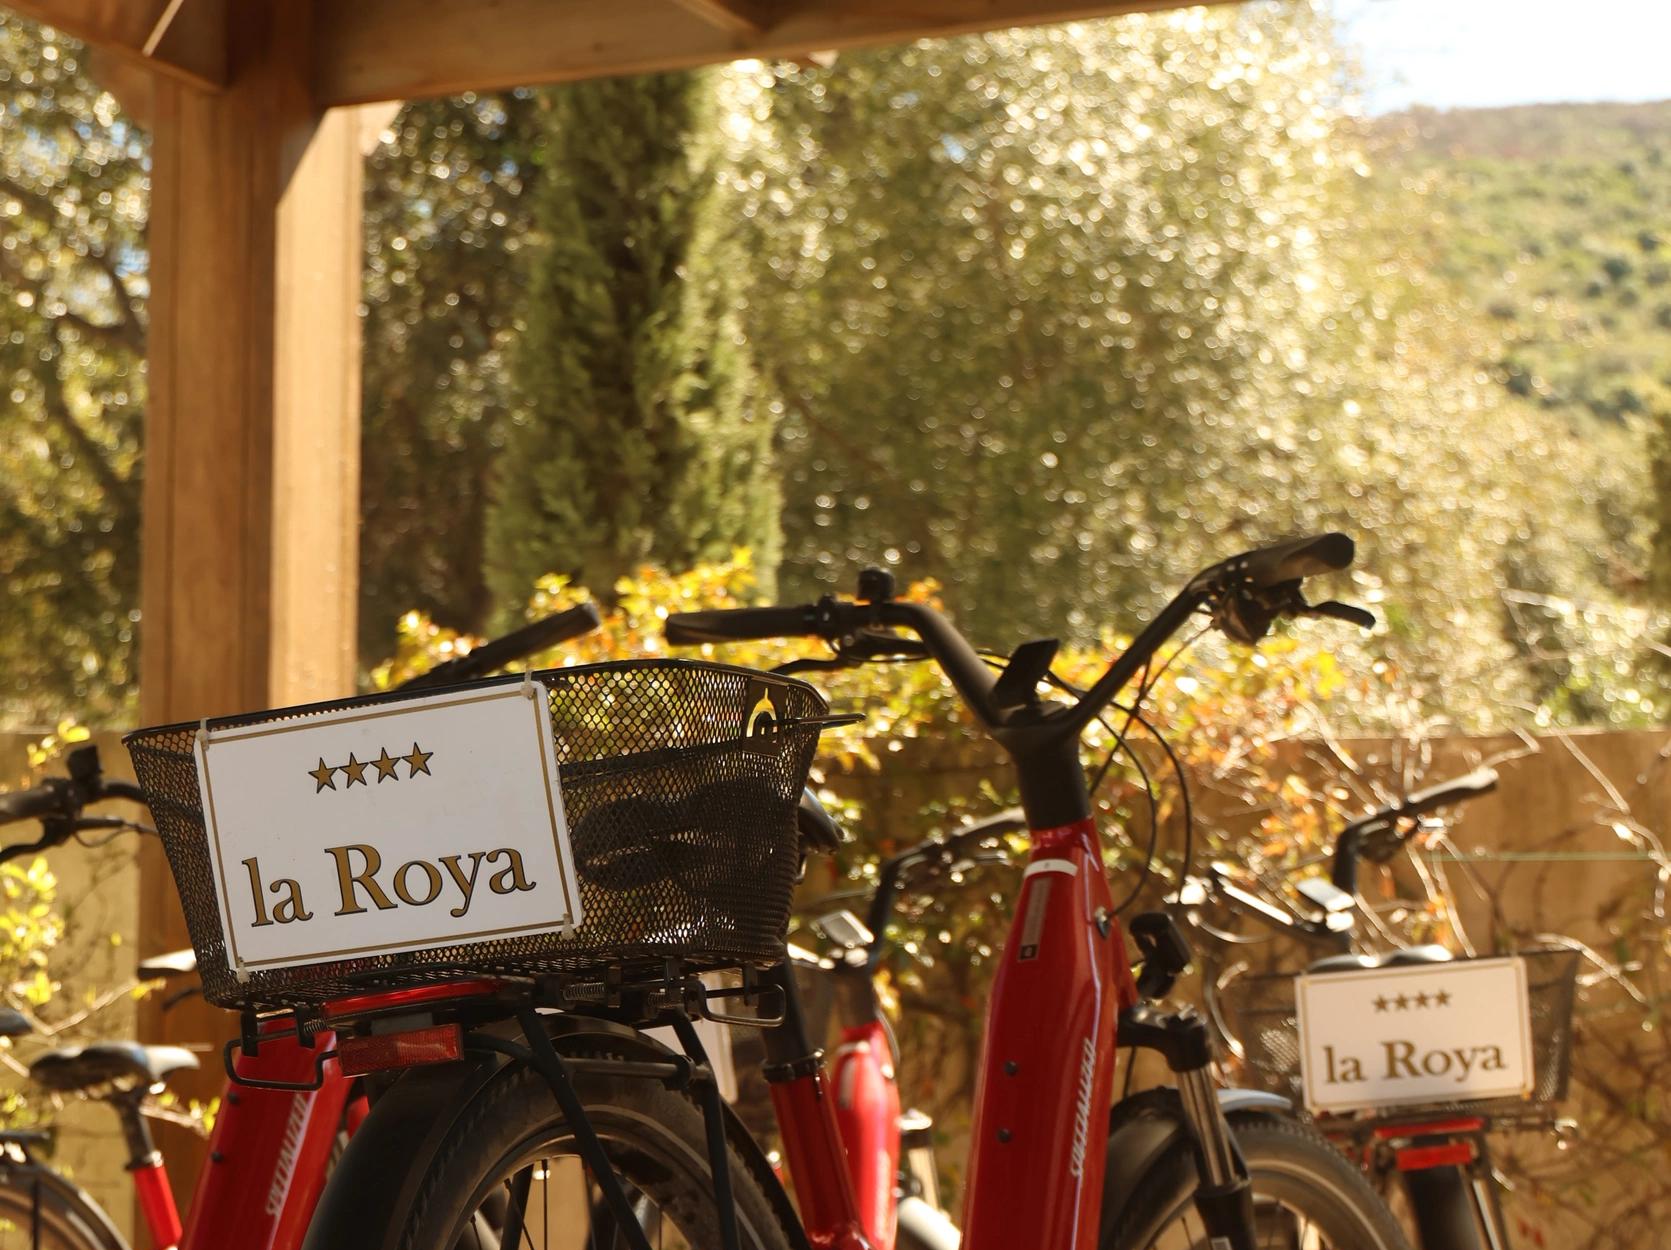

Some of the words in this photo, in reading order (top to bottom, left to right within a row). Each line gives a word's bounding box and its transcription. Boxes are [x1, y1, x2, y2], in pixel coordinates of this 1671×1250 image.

[241, 856, 314, 927] la
[324, 844, 536, 918] Roya
[1323, 1045, 1367, 1084] la
[1381, 1039, 1508, 1083] Roya
